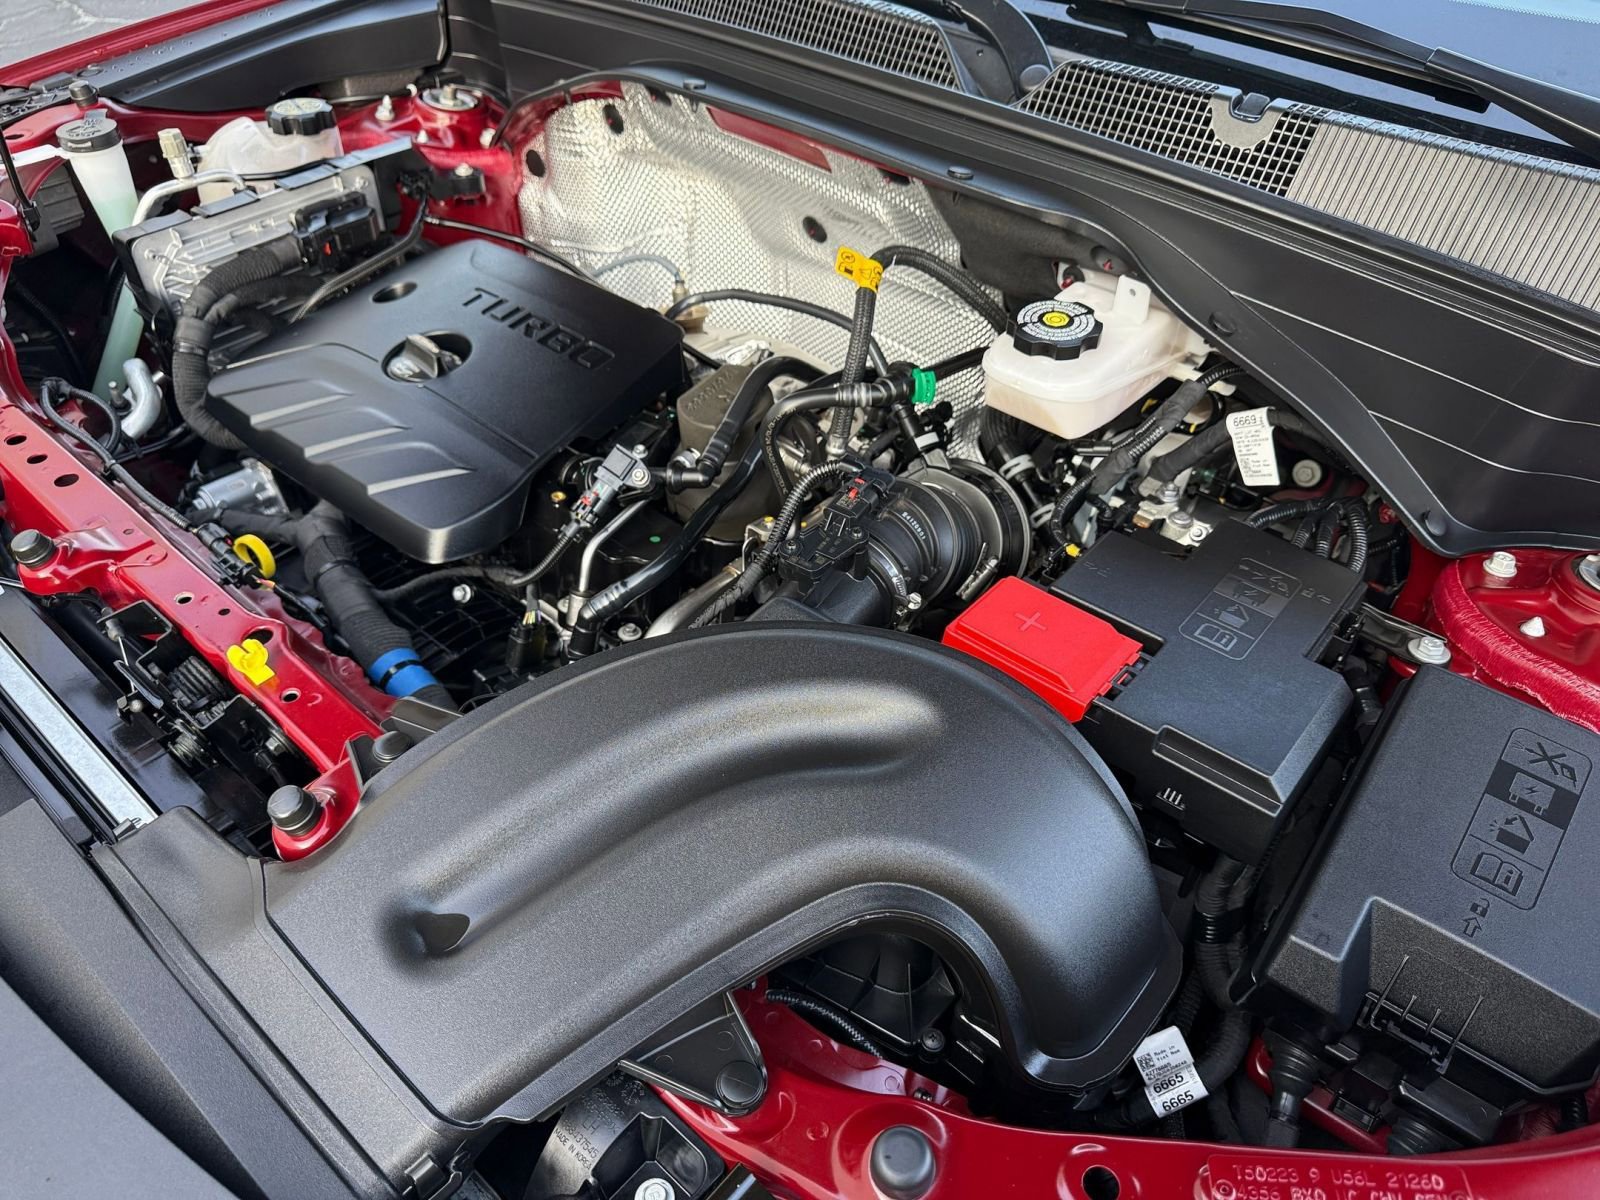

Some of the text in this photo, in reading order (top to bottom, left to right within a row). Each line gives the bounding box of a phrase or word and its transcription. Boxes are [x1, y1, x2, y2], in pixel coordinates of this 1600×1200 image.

[462, 287, 615, 370] TURBO
[1233, 414, 1257, 427] 6669
[1153, 1071, 1184, 1094] 6665
[1162, 1090, 1194, 1112] 6665
[1308, 1166, 1321, 1184] 9
